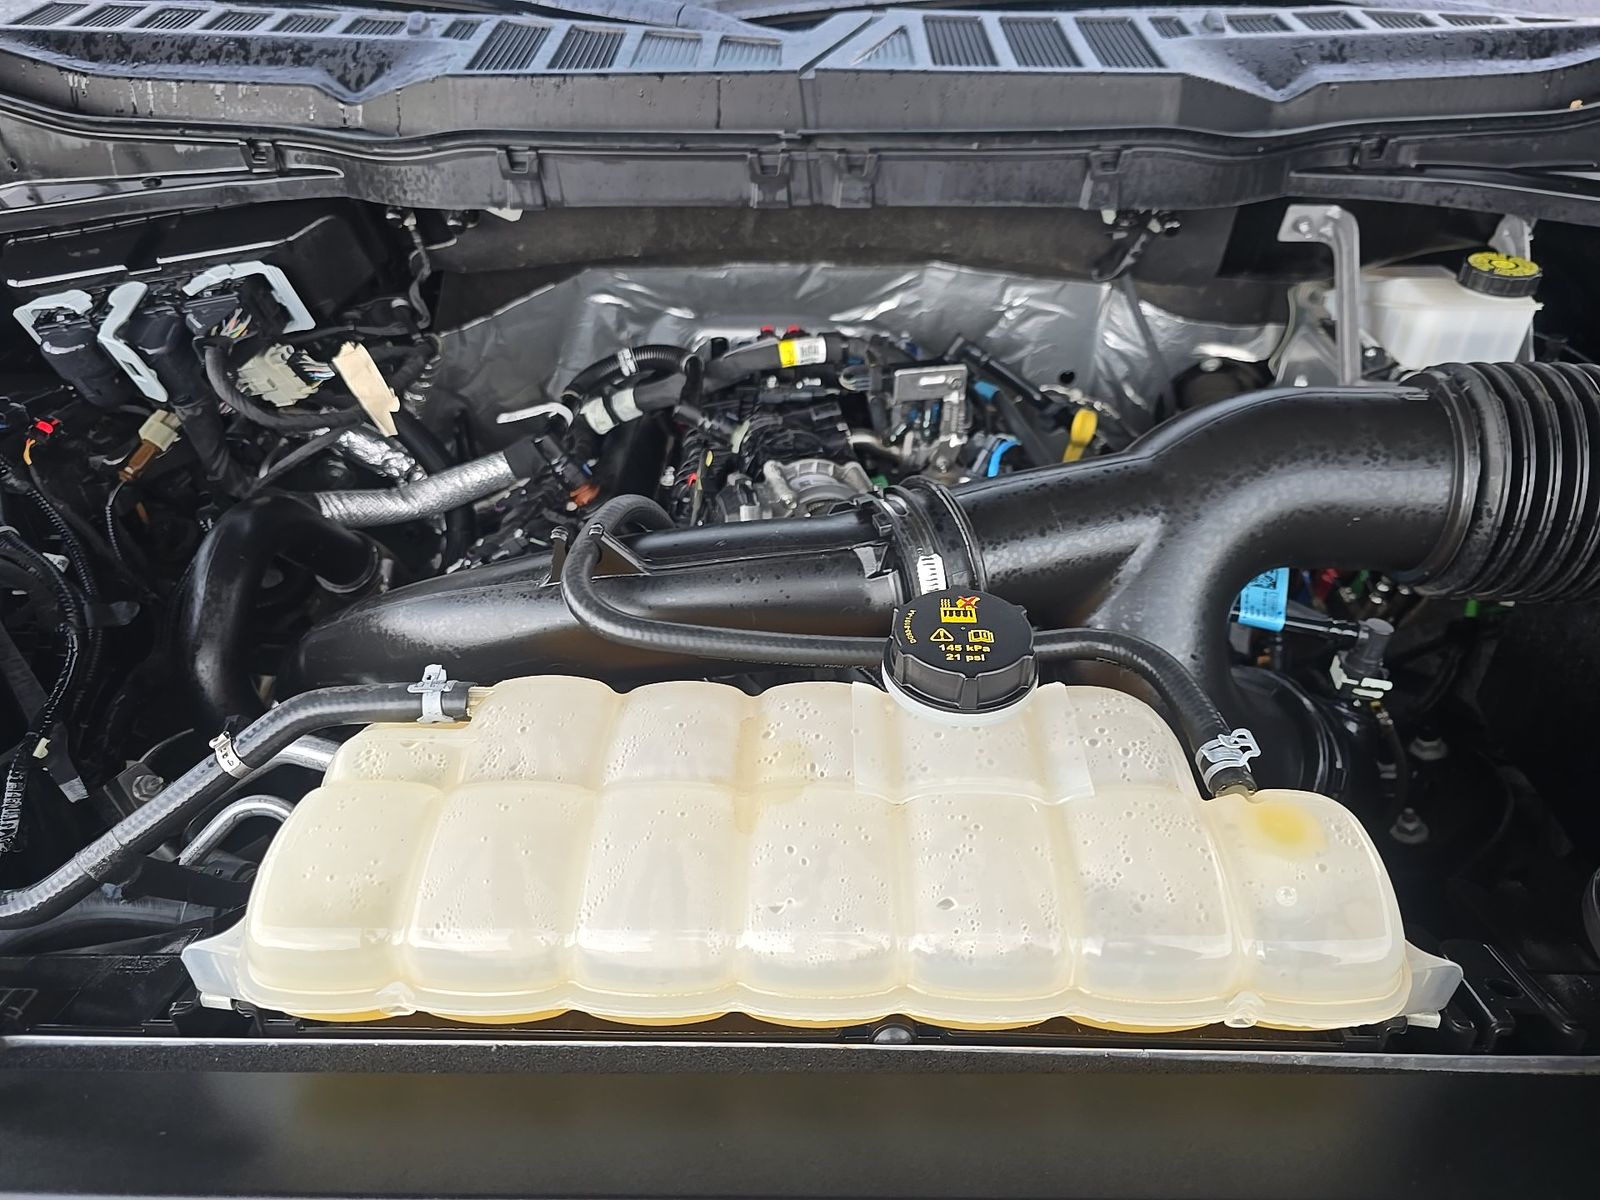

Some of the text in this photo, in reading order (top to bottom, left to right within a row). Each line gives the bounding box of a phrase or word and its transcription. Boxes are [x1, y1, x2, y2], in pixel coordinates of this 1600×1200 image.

[938, 644, 991, 652] 145 kPa
[945, 653, 985, 662] 21 psi
